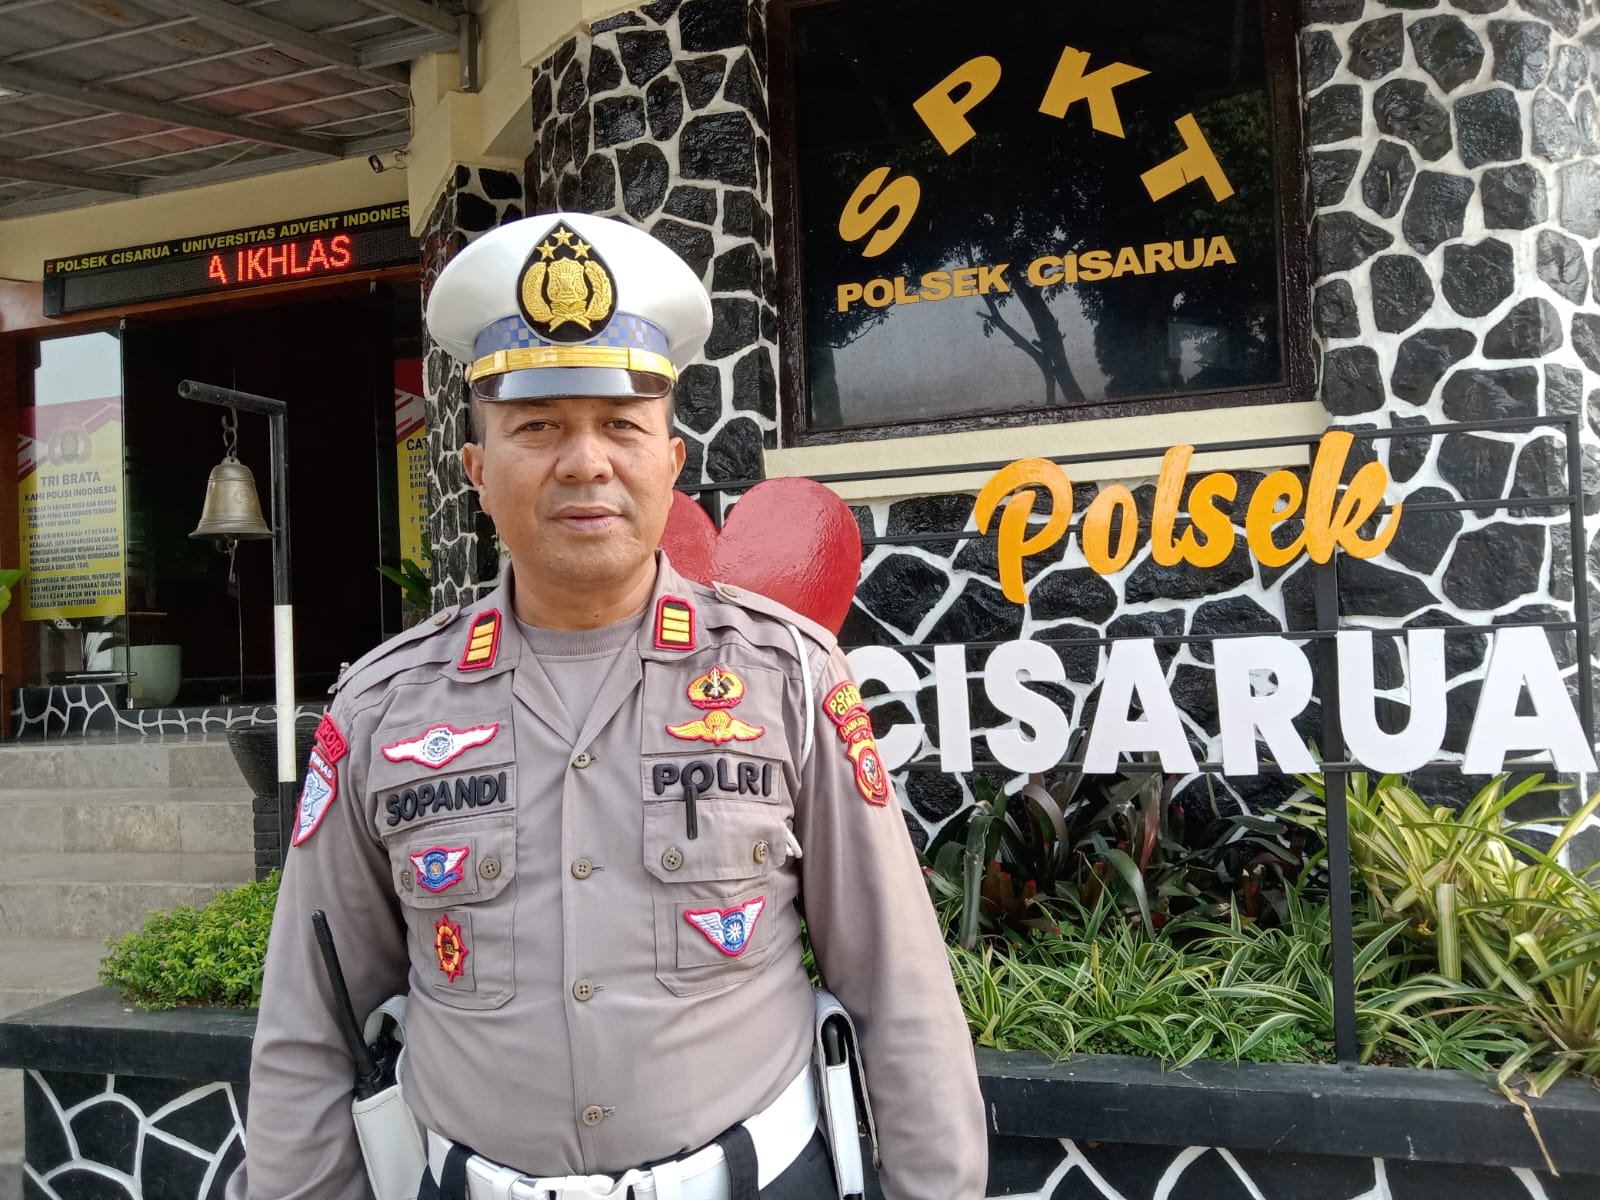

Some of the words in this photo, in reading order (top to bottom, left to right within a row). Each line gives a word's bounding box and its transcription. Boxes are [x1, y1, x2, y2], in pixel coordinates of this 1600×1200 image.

[56, 254, 108, 273] POLSEK
[111, 245, 171, 266] CISARUA
[182, 227, 276, 253] UNIVERSITAS
[279, 217, 339, 238] ADVENT
[238, 235, 353, 282] IKHLAS
[836, 264, 1010, 313] POLSEK
[1027, 236, 1238, 288] CISARUA
[24, 491, 45, 502] KAMI
[46, 489, 72, 500] POLISI
[73, 486, 117, 497] INDONESIA
[40, 475, 60, 488] TRI
[62, 471, 101, 485] BRATA
[974, 431, 1402, 604] Polsek
[846, 625, 1598, 776] CISARUA
[385, 771, 507, 827] SOPANDI
[652, 757, 772, 798] POLRI
